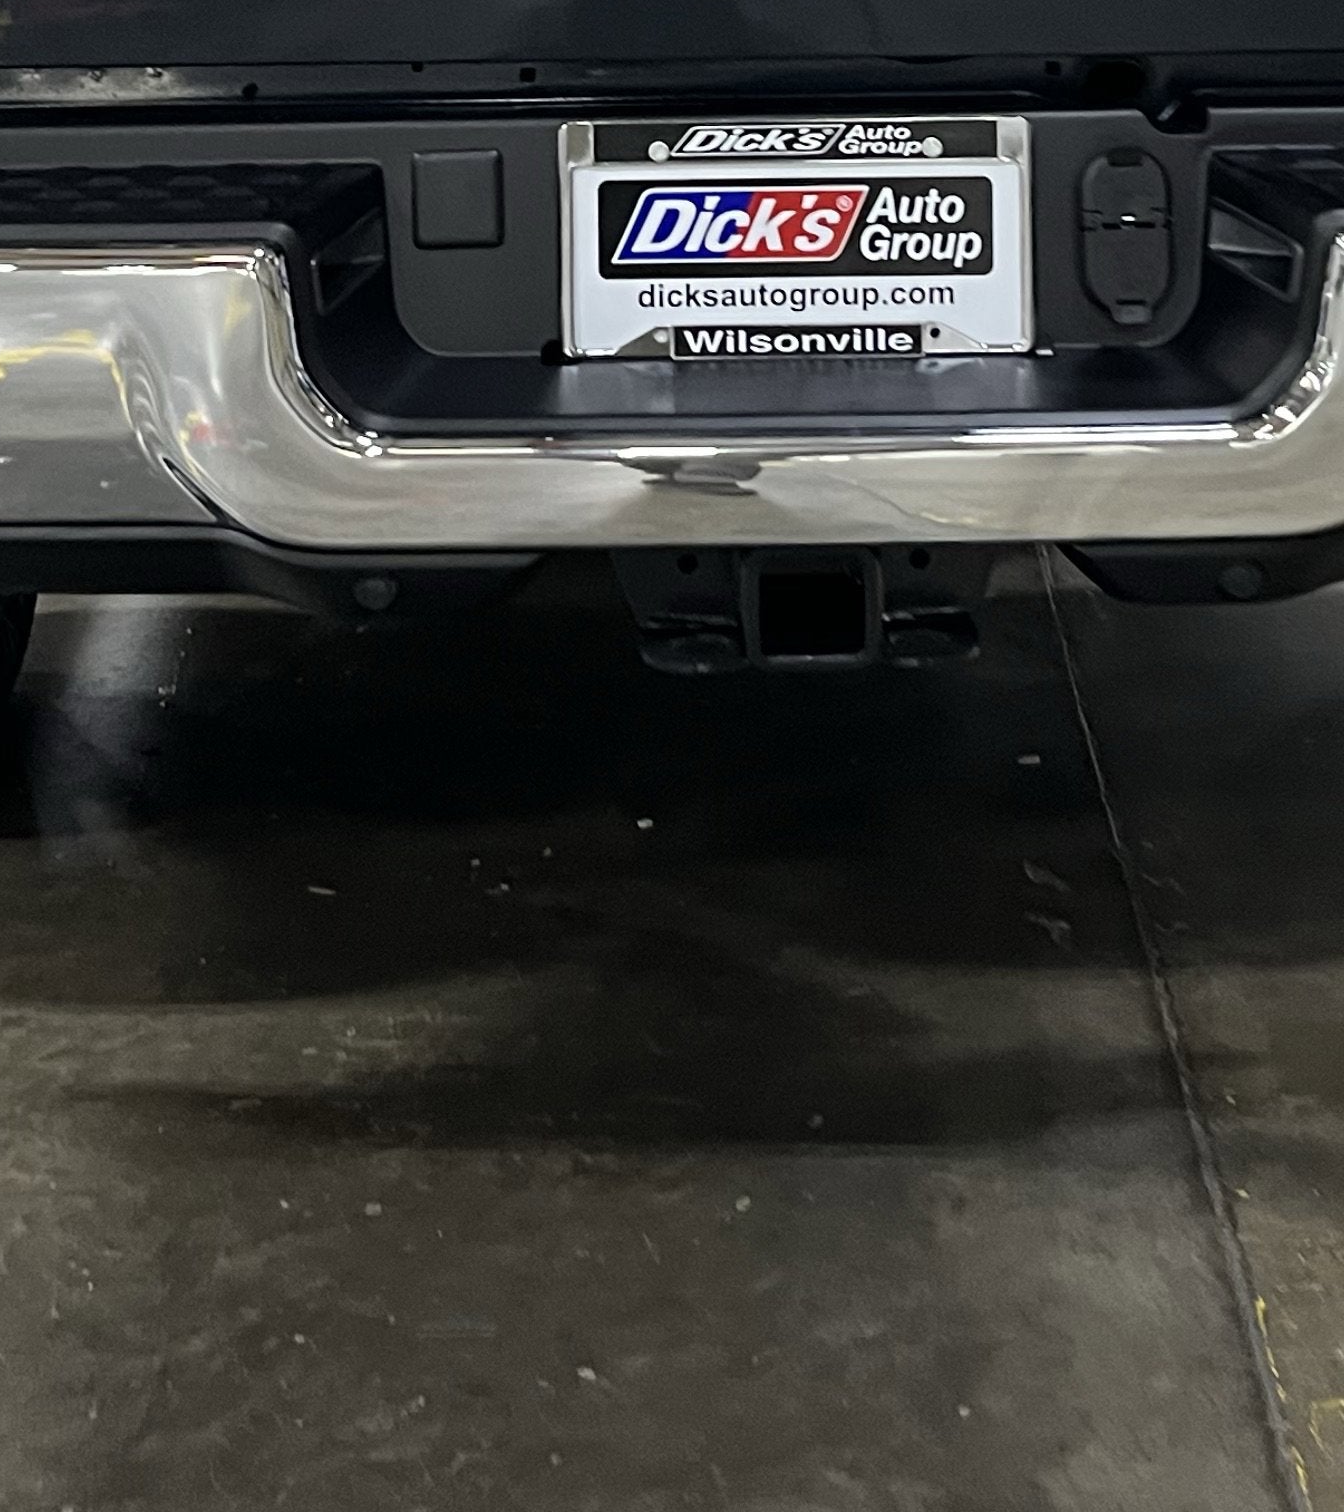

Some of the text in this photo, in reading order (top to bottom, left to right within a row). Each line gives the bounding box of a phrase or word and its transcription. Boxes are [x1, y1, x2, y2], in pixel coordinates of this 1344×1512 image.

[844, 123, 913, 141] Auto
[838, 138, 924, 157] Group
[865, 187, 966, 224] Auto
[858, 224, 983, 268] Group
[637, 283, 956, 311] dicksautogroup.com
[682, 328, 915, 354] Wilsonville
